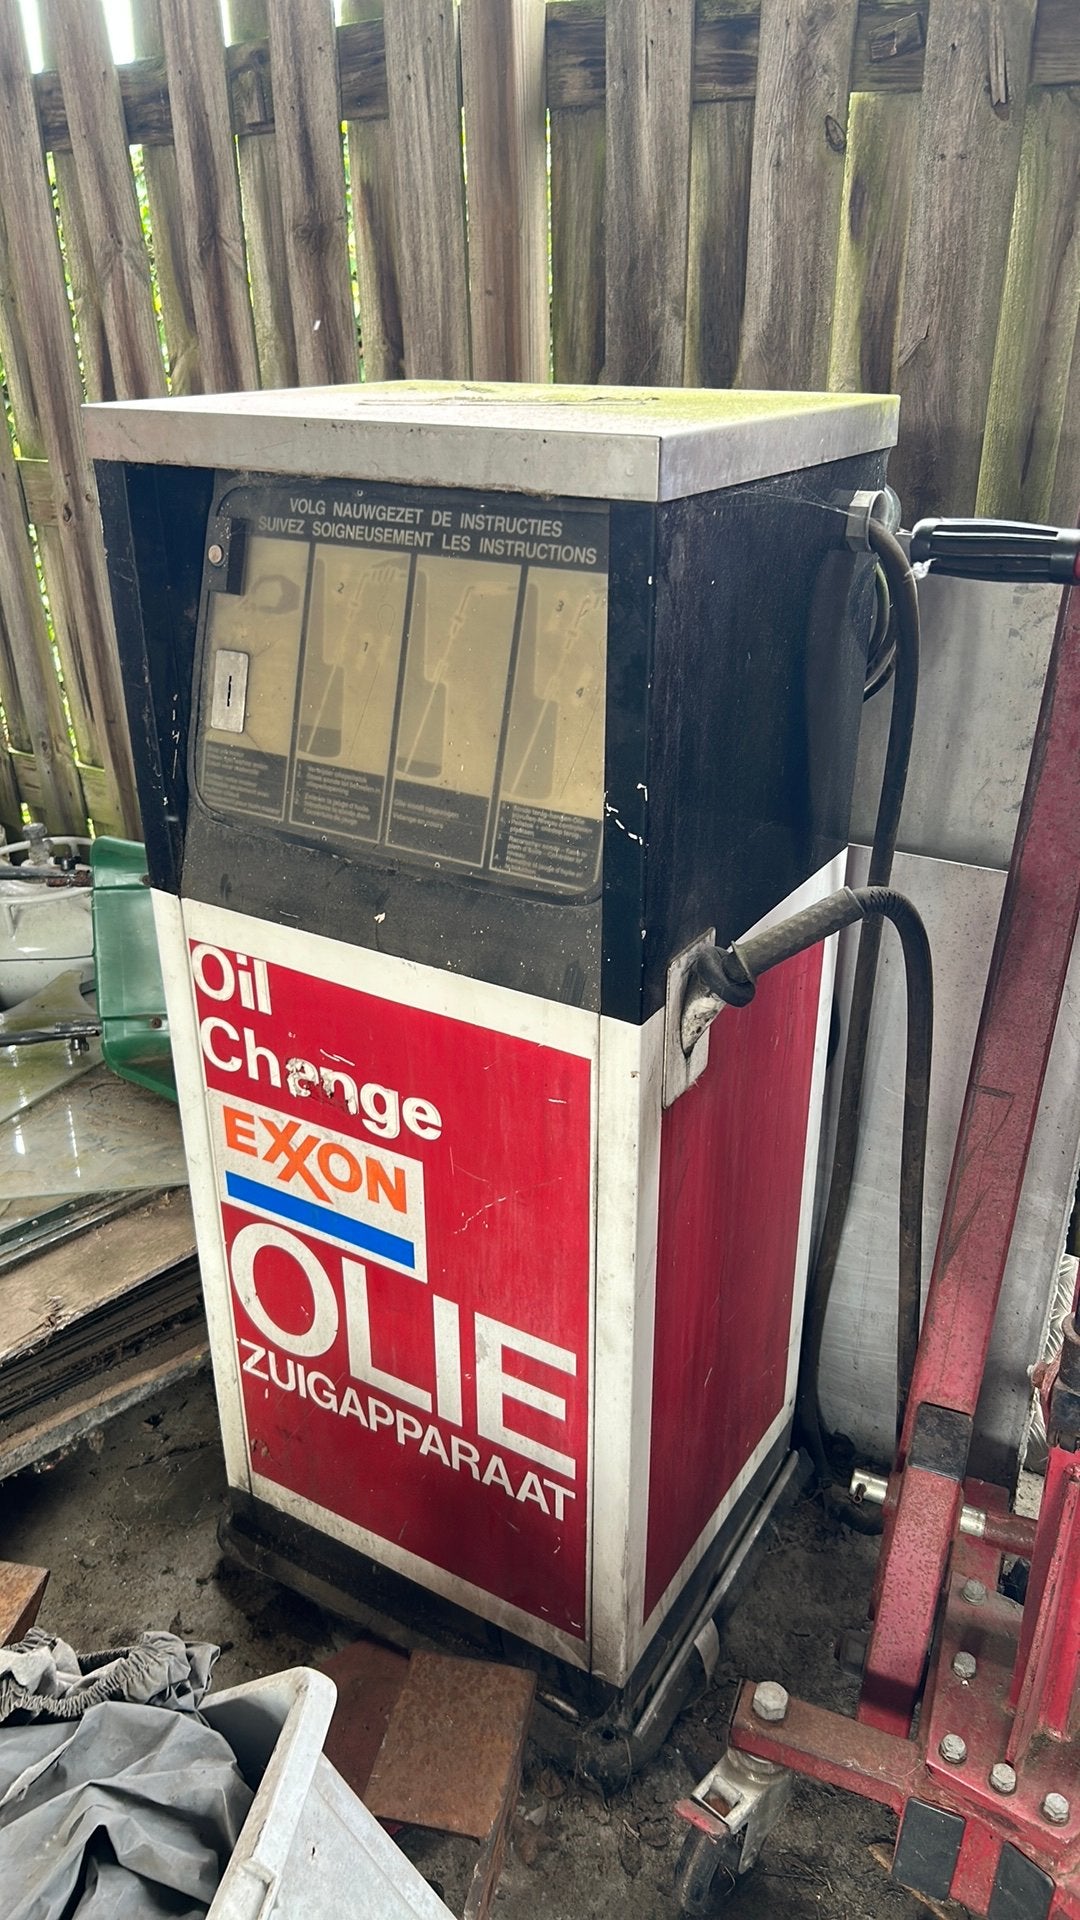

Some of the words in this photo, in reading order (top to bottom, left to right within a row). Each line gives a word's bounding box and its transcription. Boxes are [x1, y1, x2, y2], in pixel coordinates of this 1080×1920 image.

[258, 515, 304, 536] SUIVEZ
[312, 520, 434, 548] SOIGNEUSEMENT
[441, 534, 471, 552] LES
[479, 537, 597, 565] INSTRUCTIONS
[289, 497, 326, 515] VOLG
[333, 502, 423, 525] NAUWGEZET
[431, 510, 452, 528] DE
[460, 513, 563, 538] INSTRUCTIES
[191, 943, 273, 1016] Oil
[222, 1105, 408, 1215] EXXON
[230, 1222, 577, 1480] OLIE
[240, 1338, 577, 1522] ZUIGAPPARAAT
